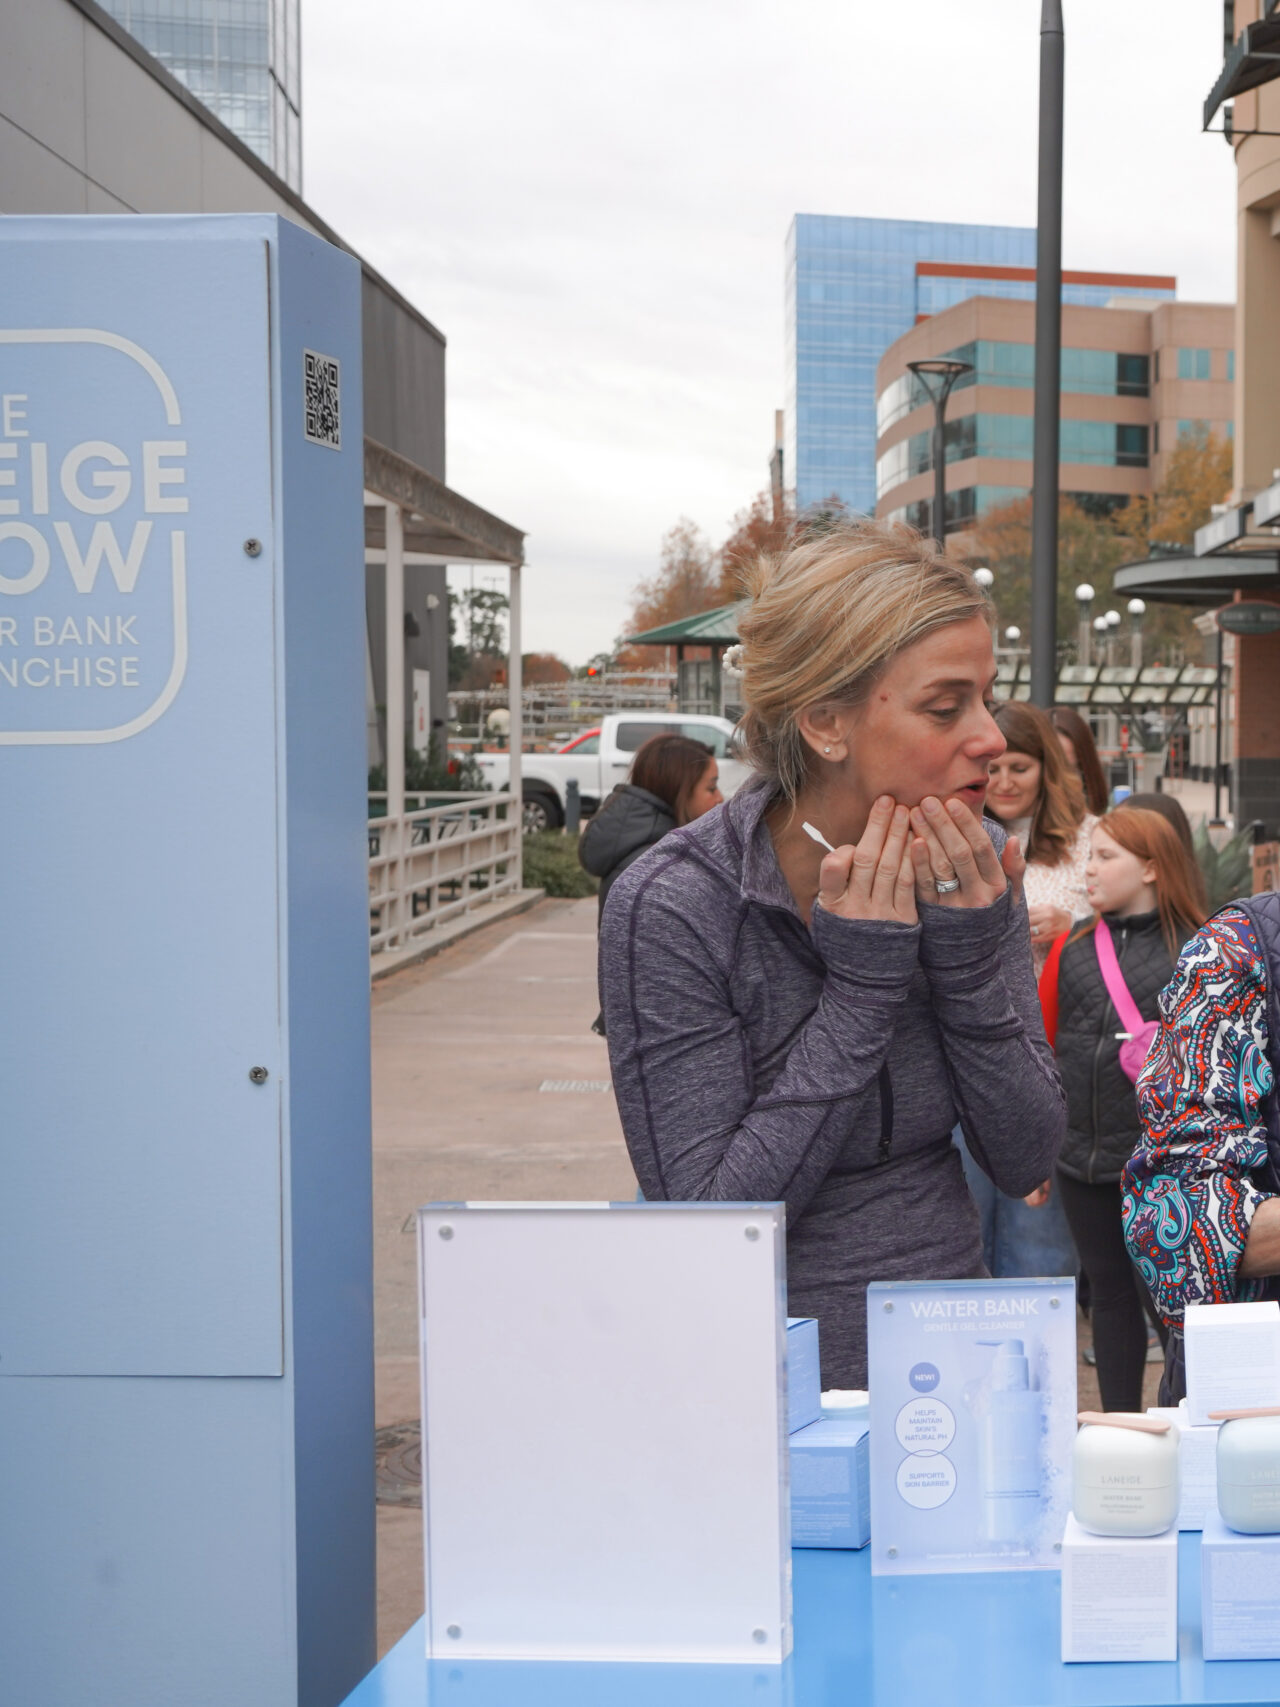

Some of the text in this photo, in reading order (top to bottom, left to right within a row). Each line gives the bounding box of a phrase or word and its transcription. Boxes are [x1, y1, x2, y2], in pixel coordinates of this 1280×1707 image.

[0, 520, 153, 595] OW
[0, 615, 140, 646] R BANK
[0, 656, 140, 687] NCHISE
[910, 1297, 1040, 1318] WATER BANK
